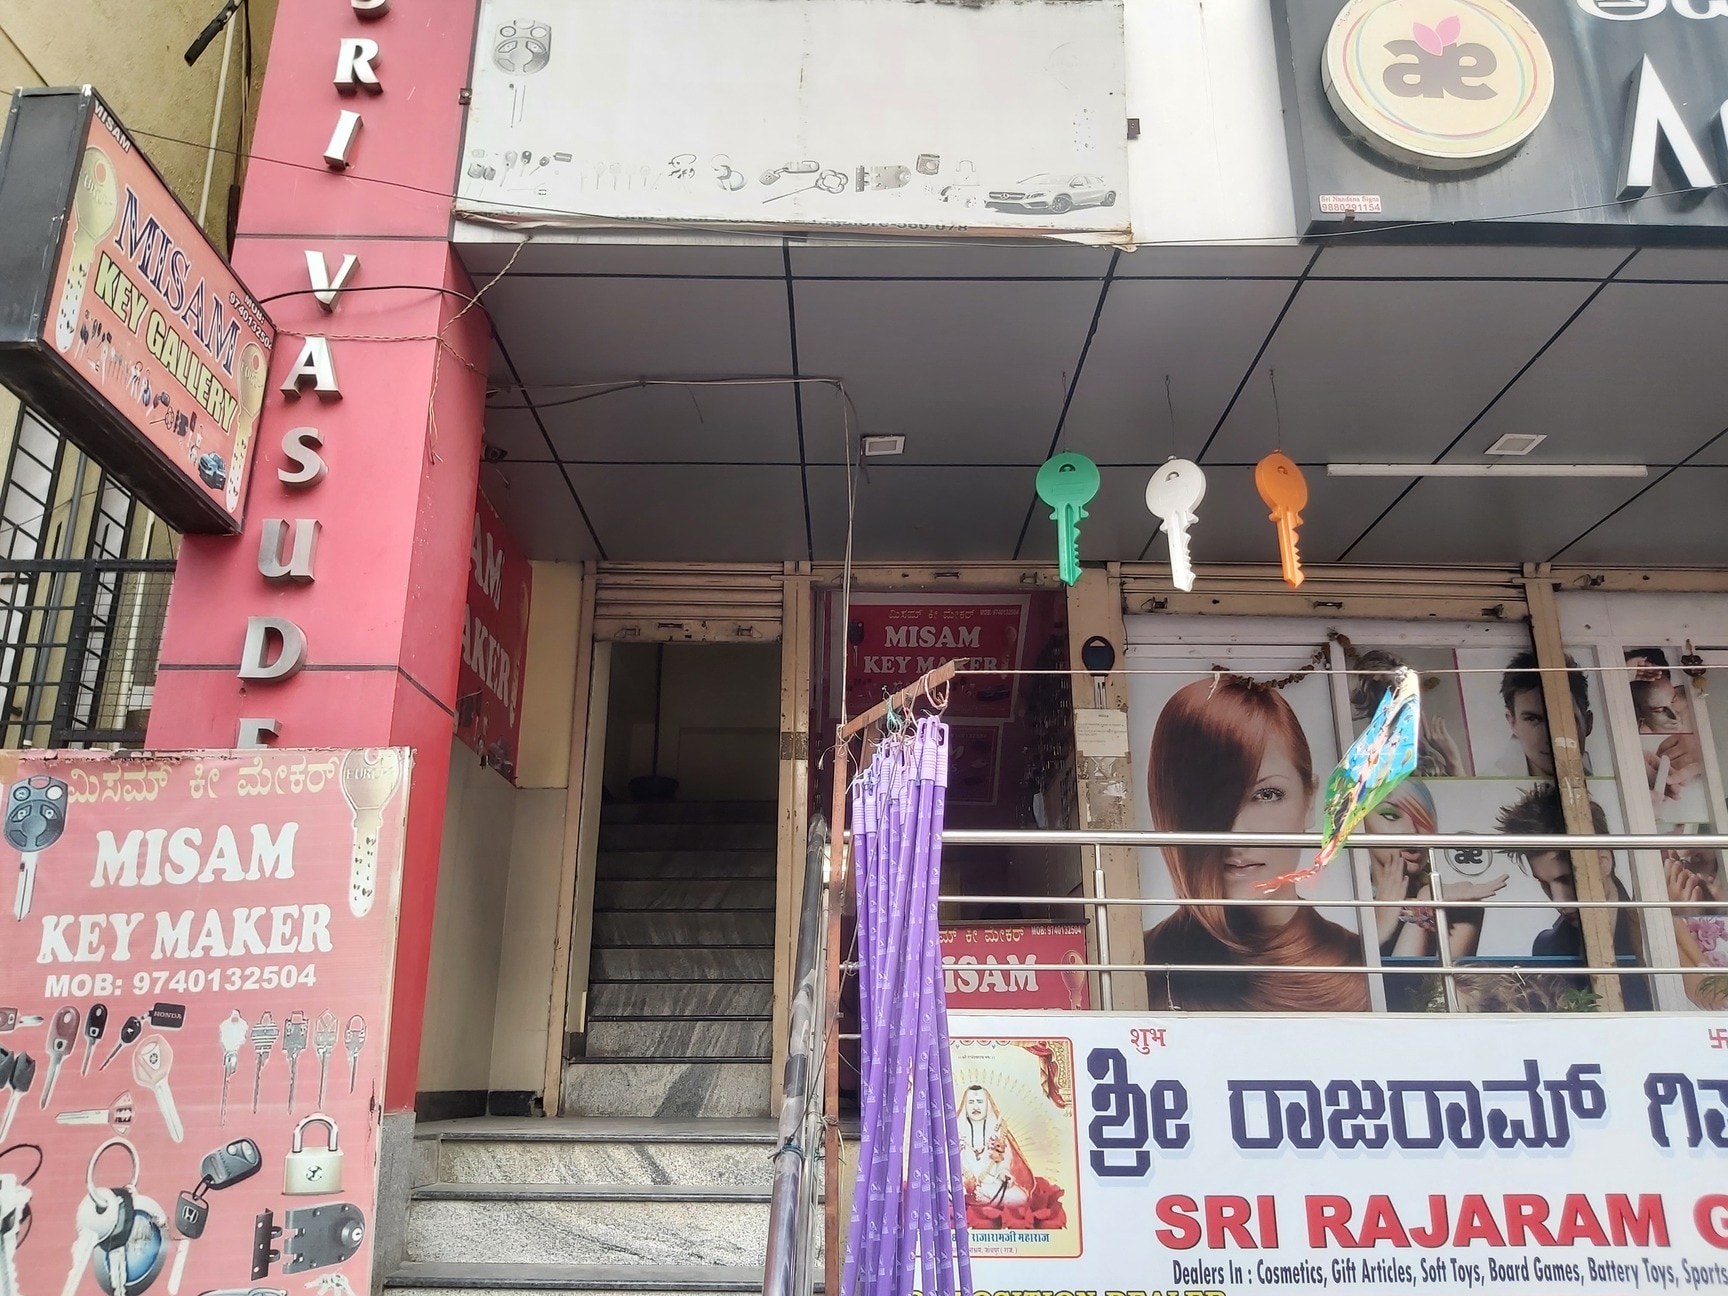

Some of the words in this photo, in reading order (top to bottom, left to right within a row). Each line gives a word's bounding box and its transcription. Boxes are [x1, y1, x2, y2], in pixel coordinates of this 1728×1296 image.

[95, 101, 132, 153] MISAM
[1616, 53, 1728, 199] A
[1321, 203, 1380, 211] 9880291154
[114, 184, 242, 379] MISAM
[245, 295, 265, 325] MOB:
[94, 250, 148, 335] KEY
[146, 309, 238, 433] GALLERY
[884, 625, 981, 648] MISAM
[864, 655, 911, 674] KEY
[68, 763, 172, 803] ಮಿಸಮ್
[189, 763, 220, 799] ಕೀ
[237, 755, 340, 797] ಮೇಕರ್
[90, 822, 299, 888] MISAM
[36, 912, 145, 964] KEY
[151, 903, 333, 961] MAKER
[1031, 926, 1047, 936] MOB:
[1048, 925, 1082, 936] 9740132504
[44, 973, 123, 998] MOB:
[132, 963, 316, 995] 9740132504
[153, 1010, 182, 1019] HONDA
[1130, 1028, 1167, 1055] शुभ
[1087, 1048, 1190, 1177] ಶ್ರೀ
[1227, 1059, 1607, 1149] ರಾಜರಾಮ್
[1155, 1194, 1279, 1250] SRI
[1304, 1193, 1671, 1249] RAJARAM
[1172, 1258, 1224, 1284] Dealers
[1229, 1259, 1243, 1284] In
[1257, 1258, 1327, 1288] Cosmetics,
[1332, 1257, 1356, 1284] Gift
[1362, 1257, 1416, 1287] Articles,
[1420, 1256, 1447, 1283] Soft
[1450, 1257, 1484, 1288] Toys,
[1488, 1256, 1530, 1282] Board
[1533, 1256, 1585, 1286] Games,
[1587, 1257, 1639, 1289] Battery
[1641, 1257, 1679, 1290] Toys,
